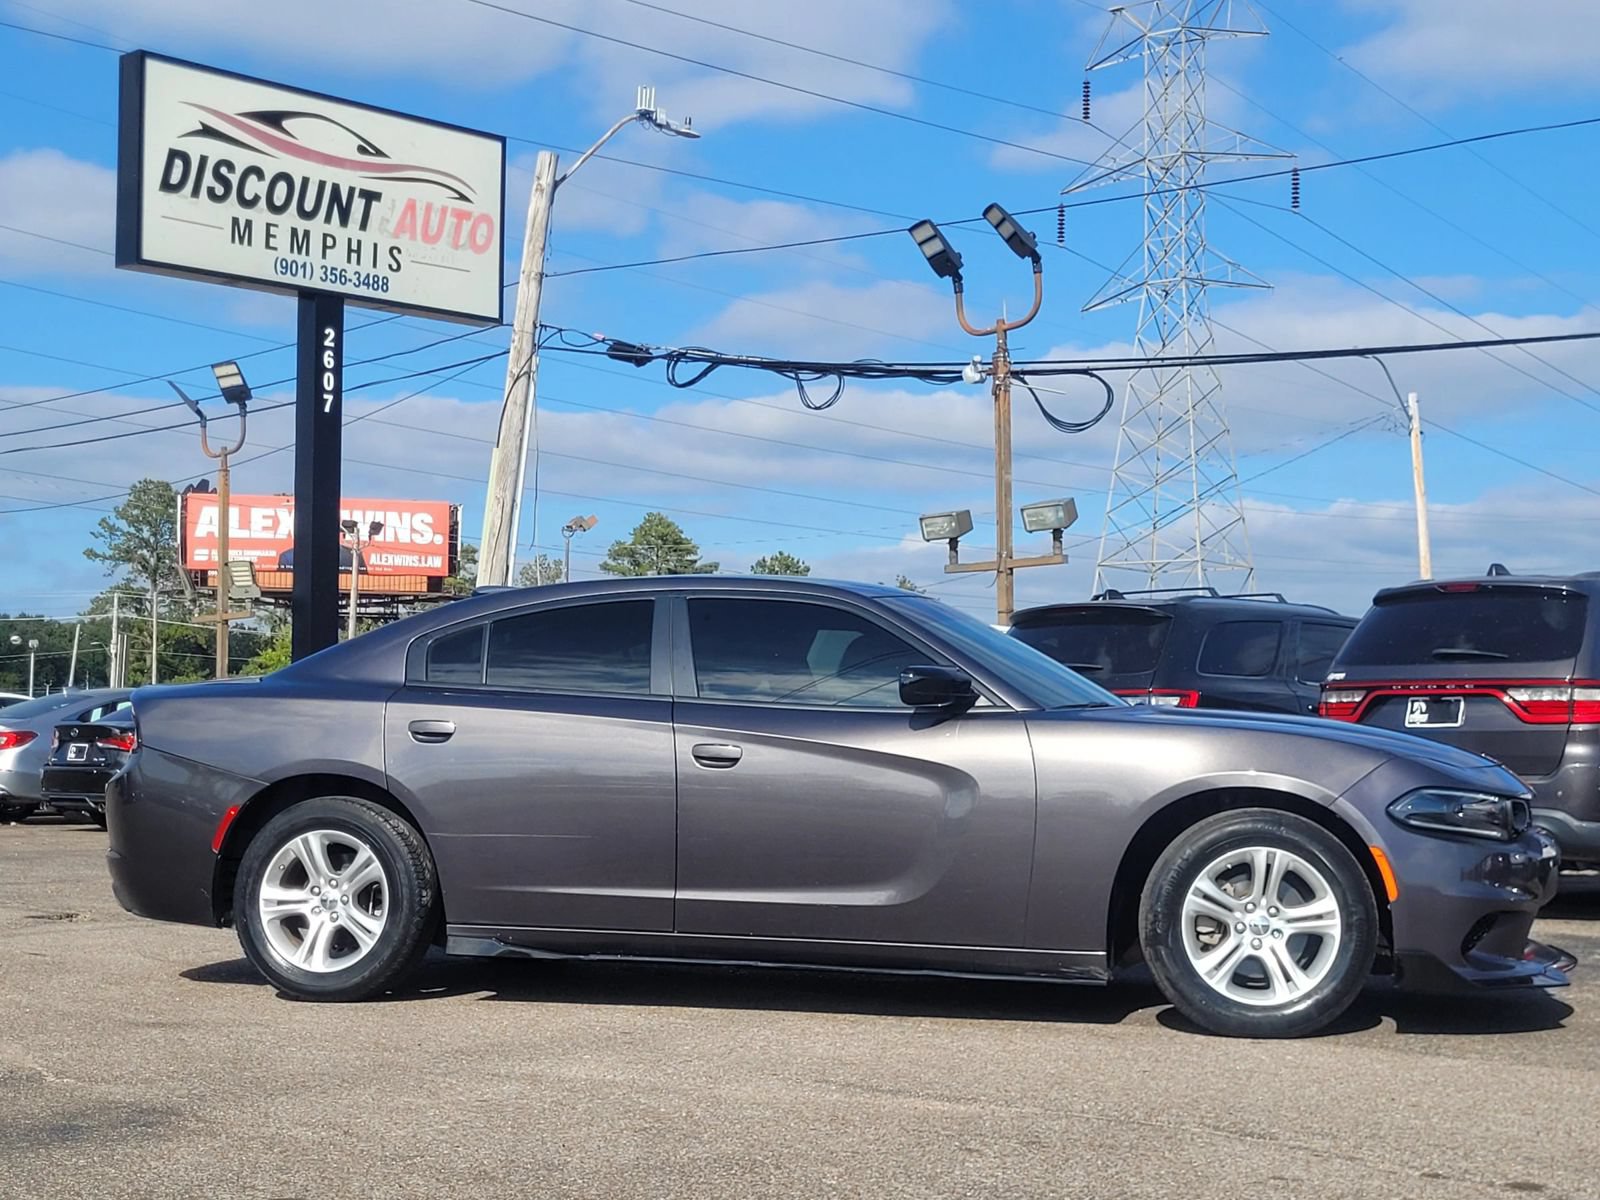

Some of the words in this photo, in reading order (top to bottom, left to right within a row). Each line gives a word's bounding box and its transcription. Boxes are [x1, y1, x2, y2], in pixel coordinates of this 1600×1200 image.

[159, 147, 383, 232] DISCOUNT
[392, 197, 495, 255] AUTO
[231, 216, 402, 273] MEMPHIS
[274, 256, 314, 281] (901)
[319, 265, 390, 293] 356-3488
[323, 327, 336, 413] 2607
[369, 552, 443, 568] ALEXWINS.LAW
